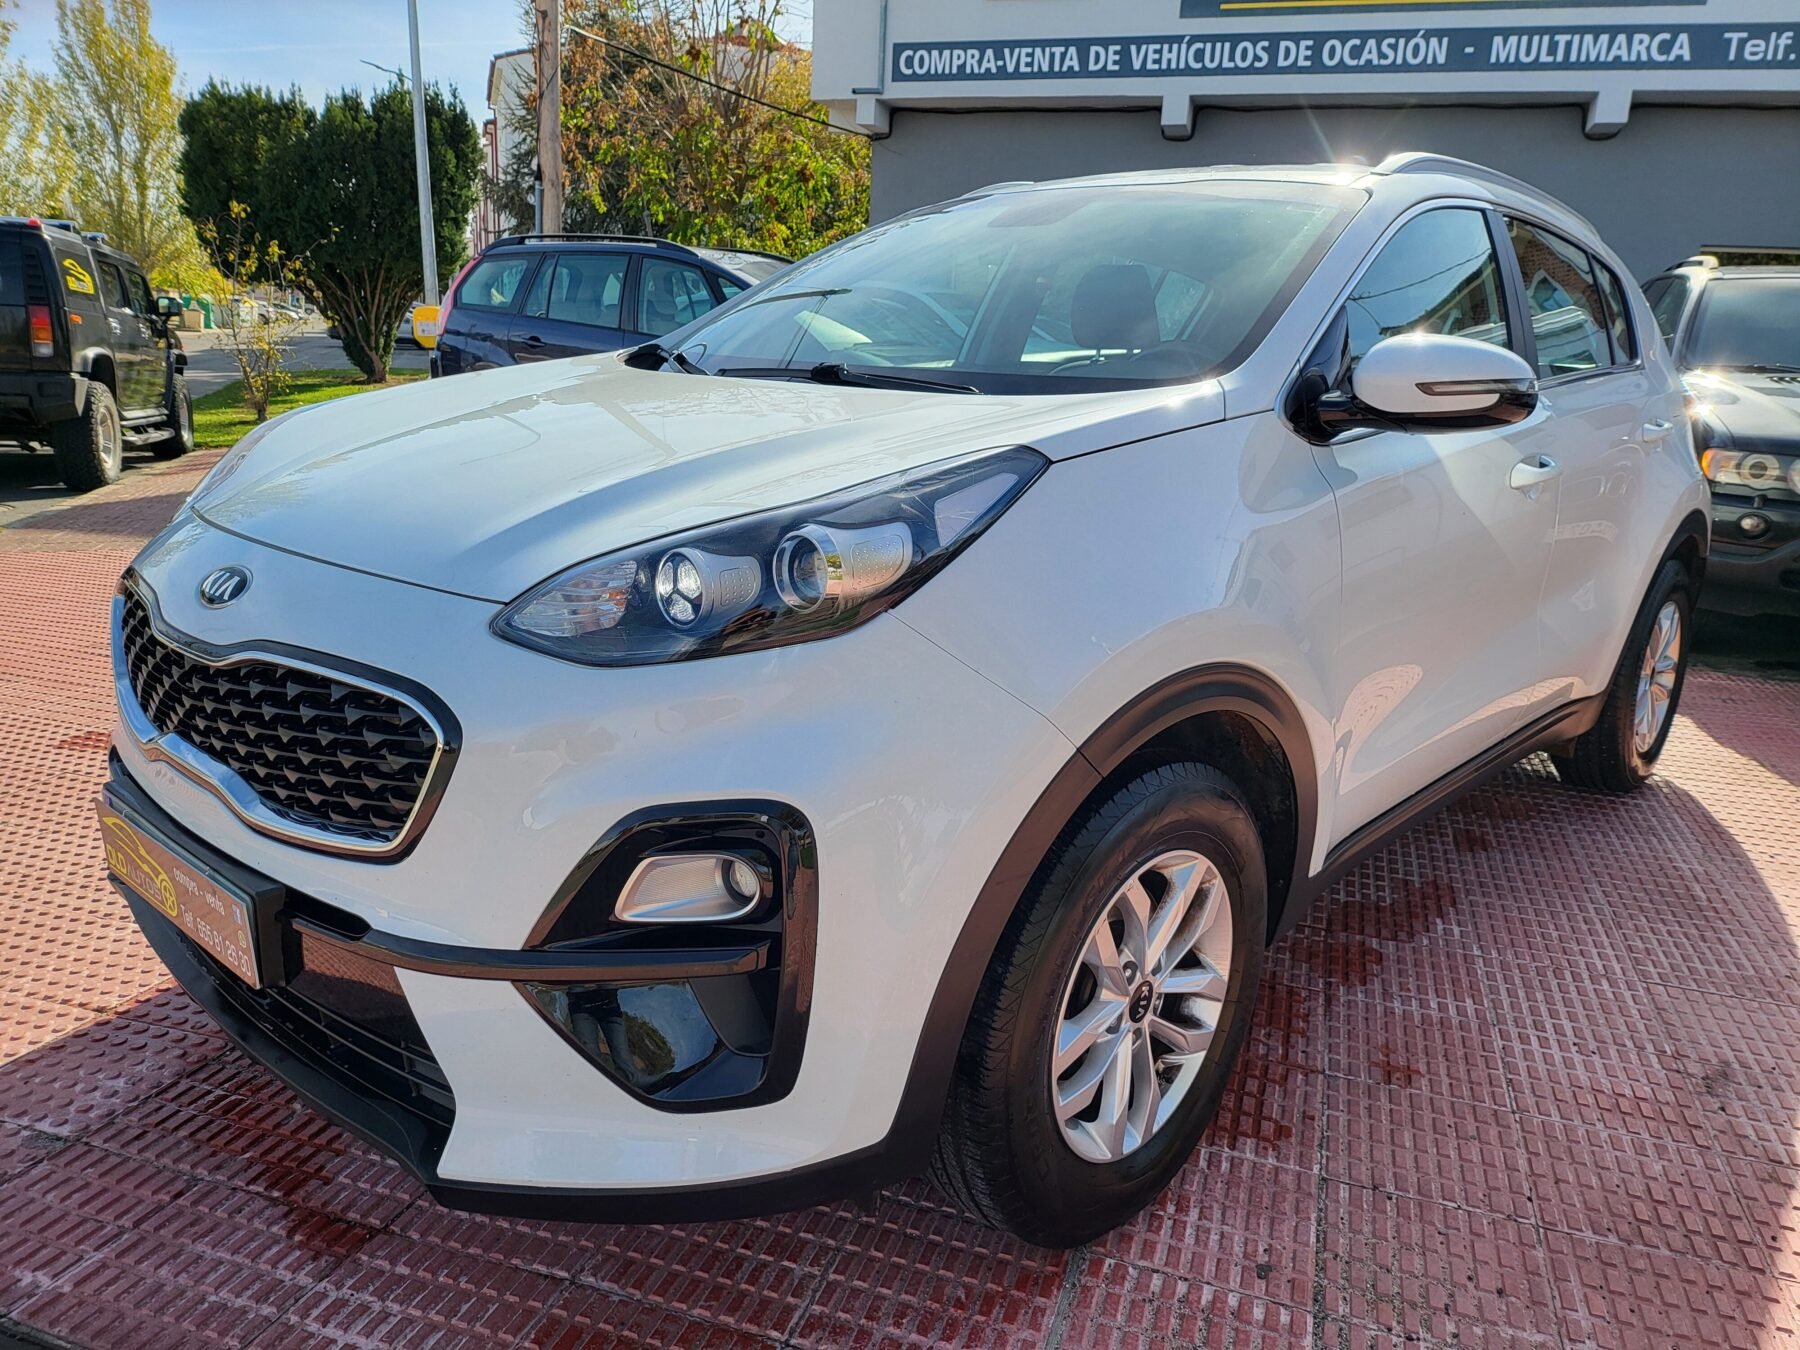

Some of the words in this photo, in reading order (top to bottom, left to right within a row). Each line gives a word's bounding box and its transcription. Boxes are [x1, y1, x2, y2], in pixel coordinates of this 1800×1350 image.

[899, 46, 1080, 75] COMPRA-VENTA
[1088, 45, 1121, 71] DE
[1130, 36, 1269, 70] VEHÍCULOS
[1277, 40, 1314, 67] DE
[1321, 30, 1448, 66] OCASIÓN
[1490, 33, 1692, 63] MULTIMARCA
[1723, 31, 1797, 61] Telf.
[127, 862, 162, 901] AUTOS
[173, 867, 199, 897] compra
[204, 890, 225, 916] venta
[225, 940, 239, 966] 26
[238, 951, 252, 977] 30
[1135, 985, 1150, 1020] KIA
